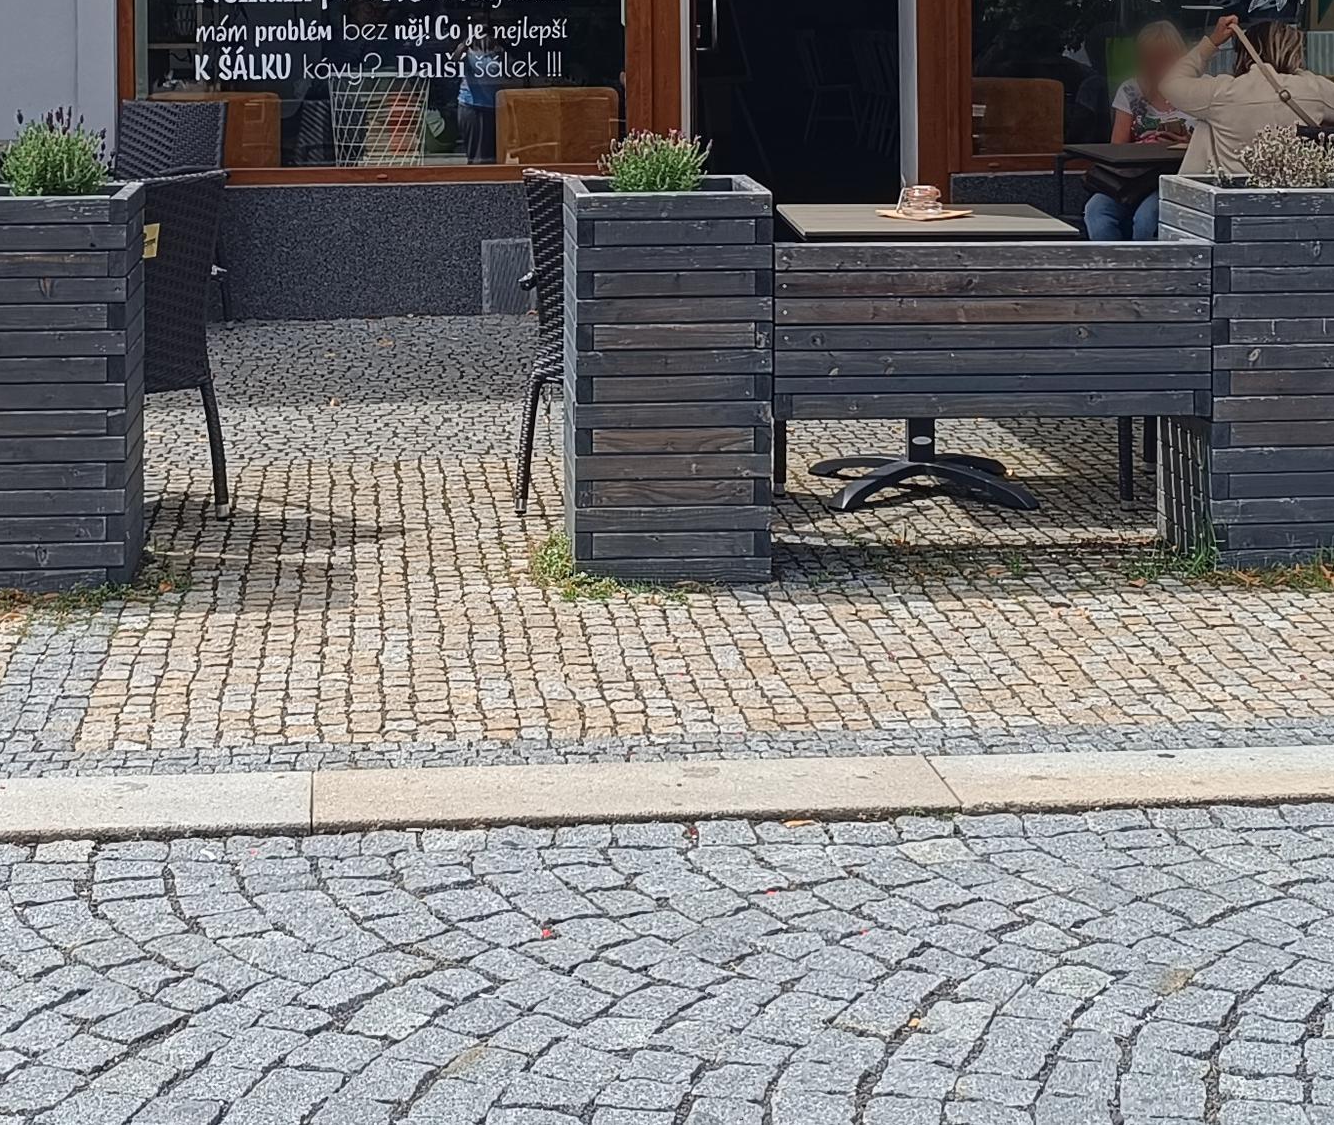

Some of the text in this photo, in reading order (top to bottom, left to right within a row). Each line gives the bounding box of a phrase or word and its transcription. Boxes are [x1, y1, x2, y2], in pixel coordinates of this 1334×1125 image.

[195, 14, 568, 47] mám problém bez něj! Co je nejlepší
[194, 54, 211, 81] K
[218, 45, 292, 81] ŠÁLKU
[303, 52, 383, 85] kávy?
[395, 54, 467, 78] Další
[474, 53, 540, 78] šálek
